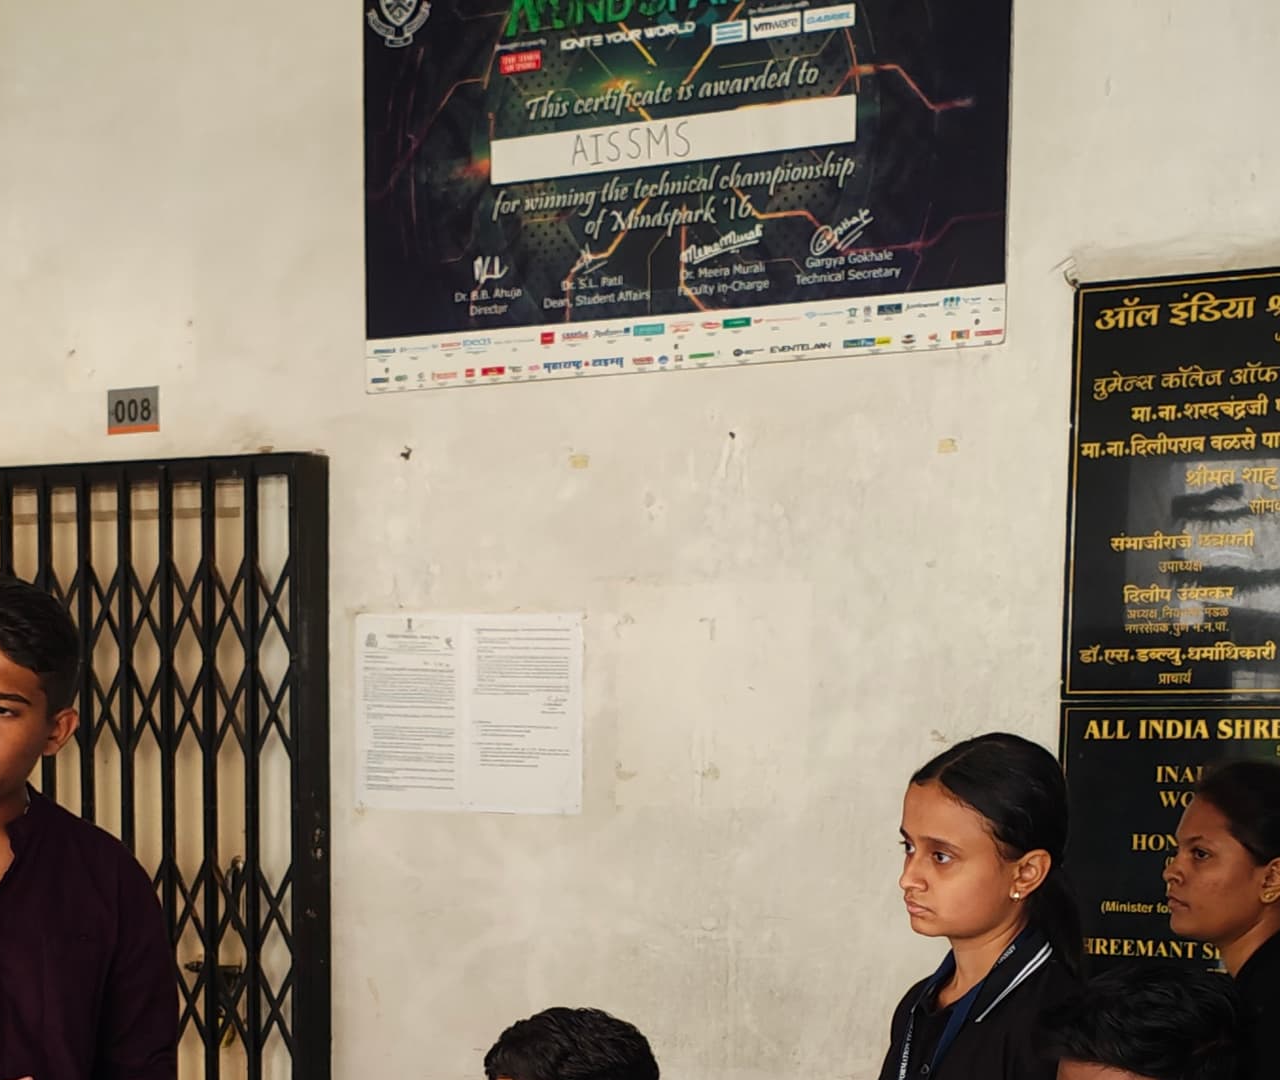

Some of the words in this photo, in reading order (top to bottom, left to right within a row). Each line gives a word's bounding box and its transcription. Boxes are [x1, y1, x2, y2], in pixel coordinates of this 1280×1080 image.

[525, 90, 569, 121] This
[573, 78, 671, 116] certificate
[699, 58, 796, 97] awarded
[798, 61, 820, 86] to
[571, 121, 692, 165] AISSMS
[492, 191, 520, 221] for
[524, 186, 595, 219] winning
[600, 175, 629, 204] the
[633, 165, 720, 201] technical
[720, 153, 856, 197] championship
[610, 202, 717, 237] Mindspark
[796, 268, 844, 286] Technical
[845, 264, 902, 283] Secretary
[1095, 297, 1160, 330] ऑल
[1170, 291, 1256, 326] इंडिया
[1161, 365, 1225, 389] कॉलेज
[114, 398, 152, 423] 008
[1084, 719, 1131, 740] ALL
[1139, 718, 1208, 740] INDIA
